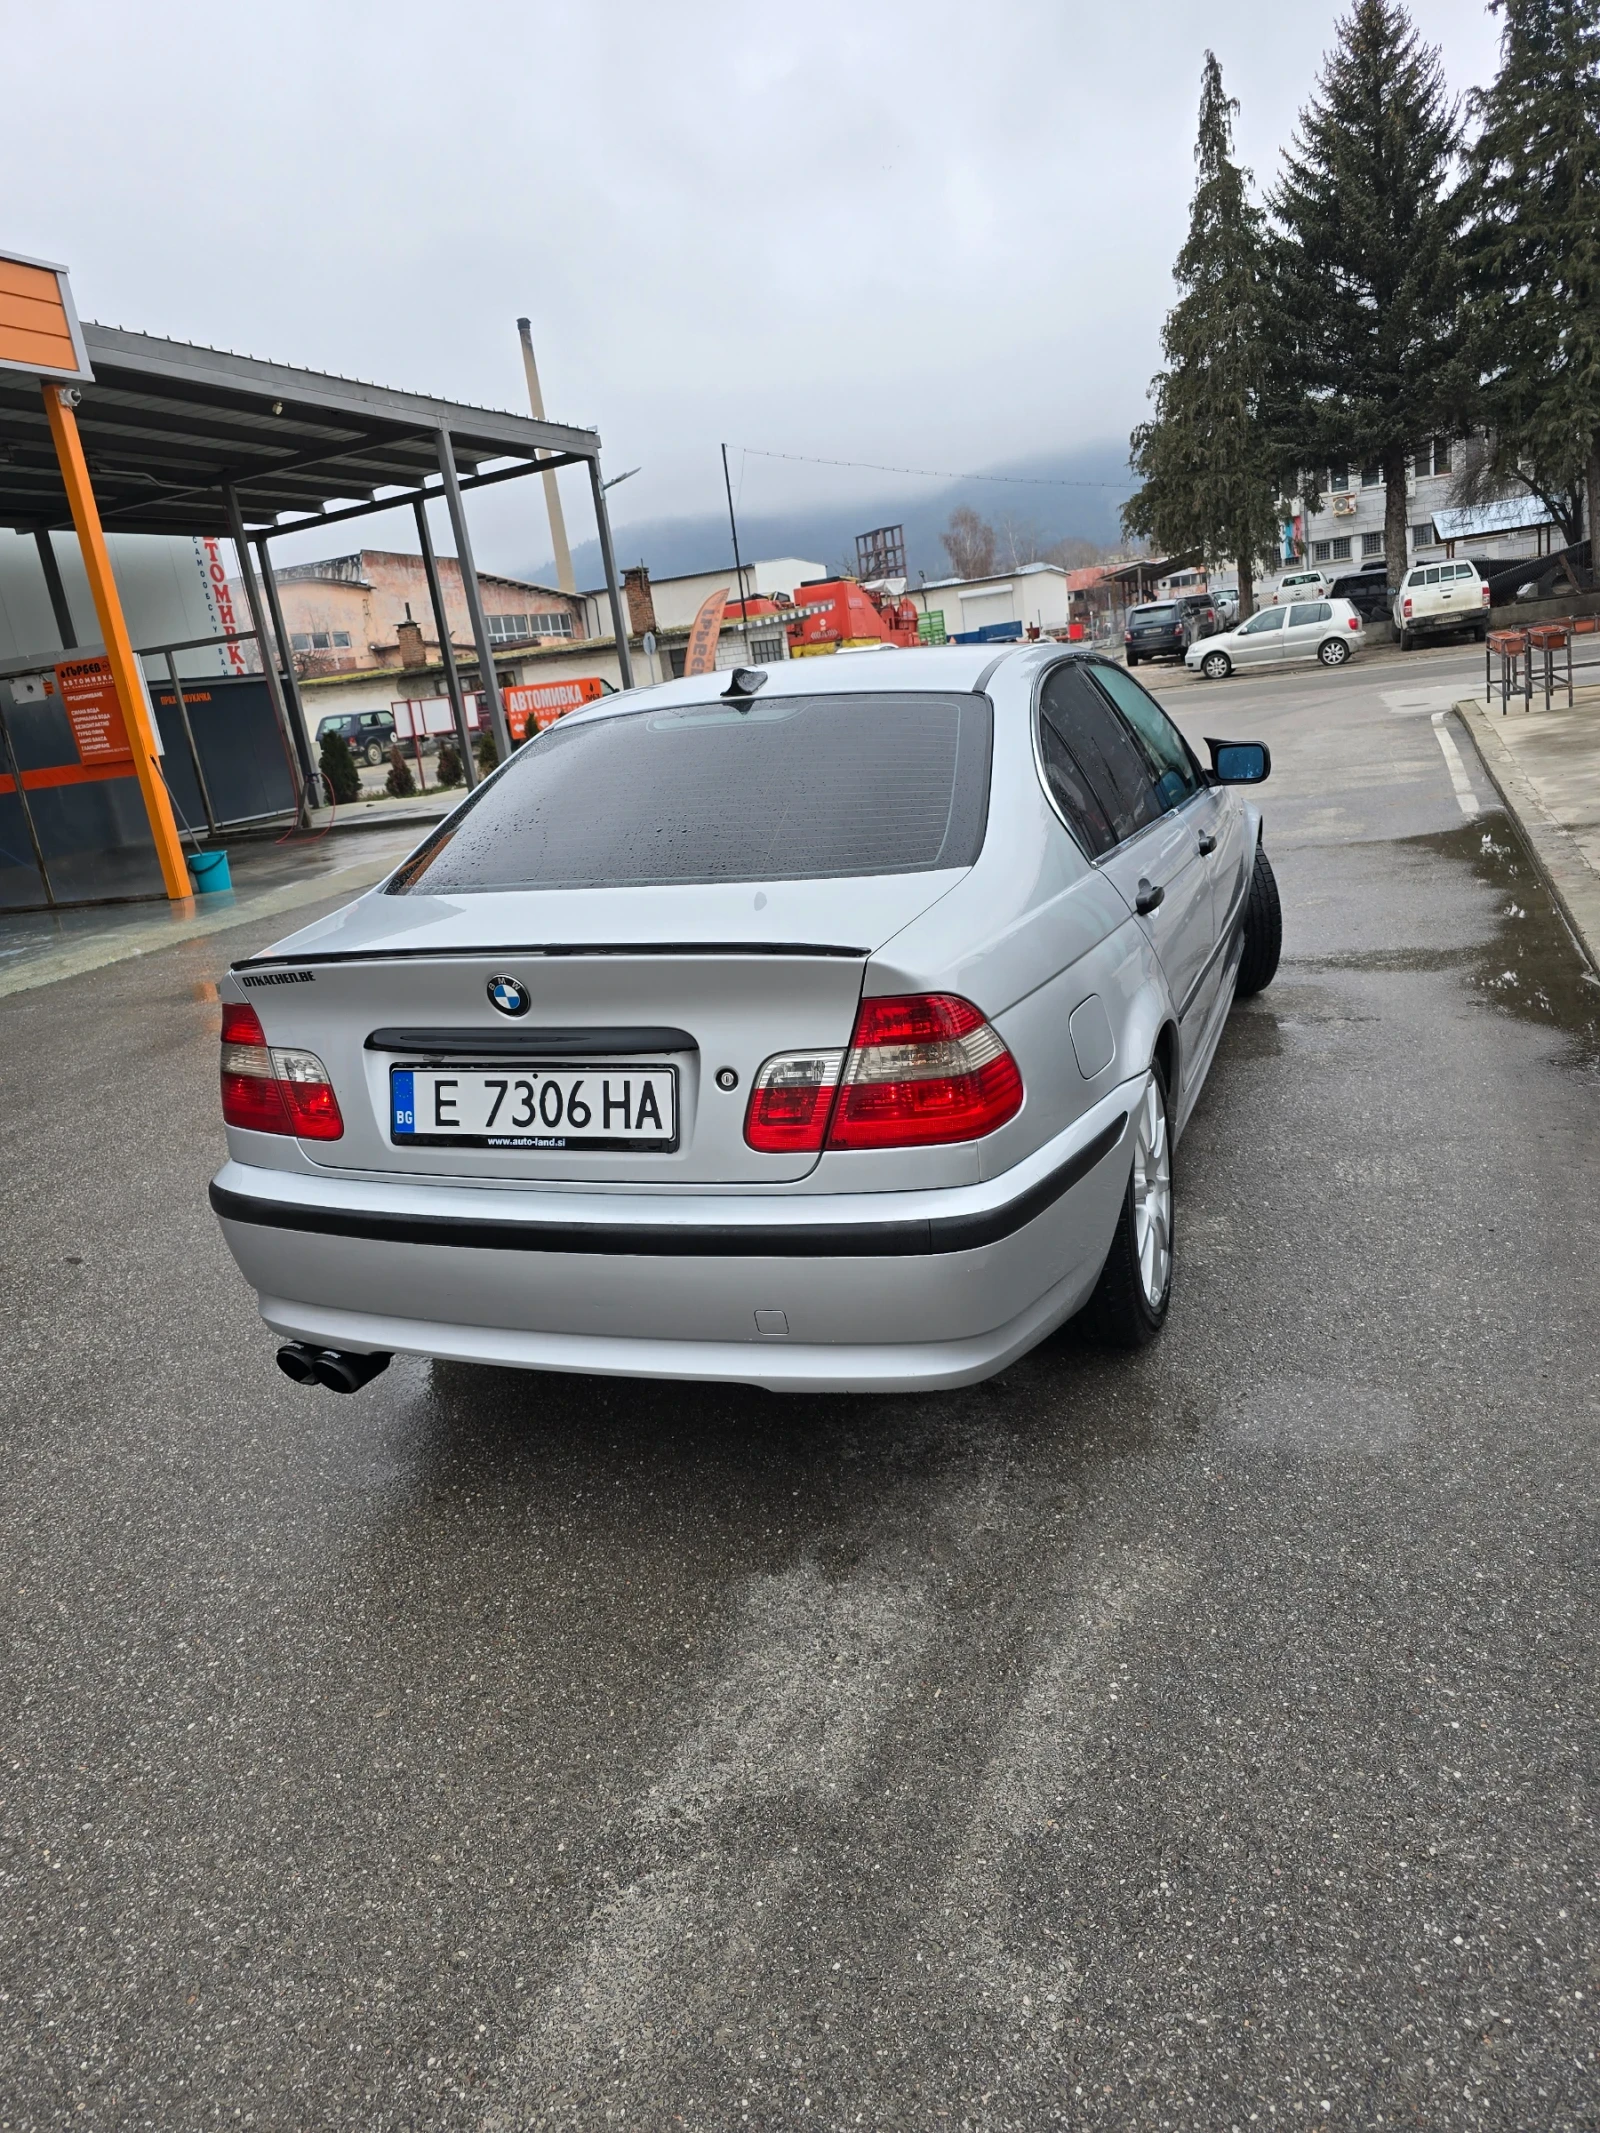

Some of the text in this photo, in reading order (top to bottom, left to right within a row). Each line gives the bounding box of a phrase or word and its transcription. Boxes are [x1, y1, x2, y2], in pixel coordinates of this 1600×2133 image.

[63, 674, 113, 687] АВТОМИВКА
[509, 684, 583, 712] АВТОМИВКА
[488, 977, 521, 991] BMW
[434, 1080, 663, 1130] E 7306 HA
[396, 1110, 413, 1125] BG
[487, 1136, 566, 1147] www.auto-land.si
